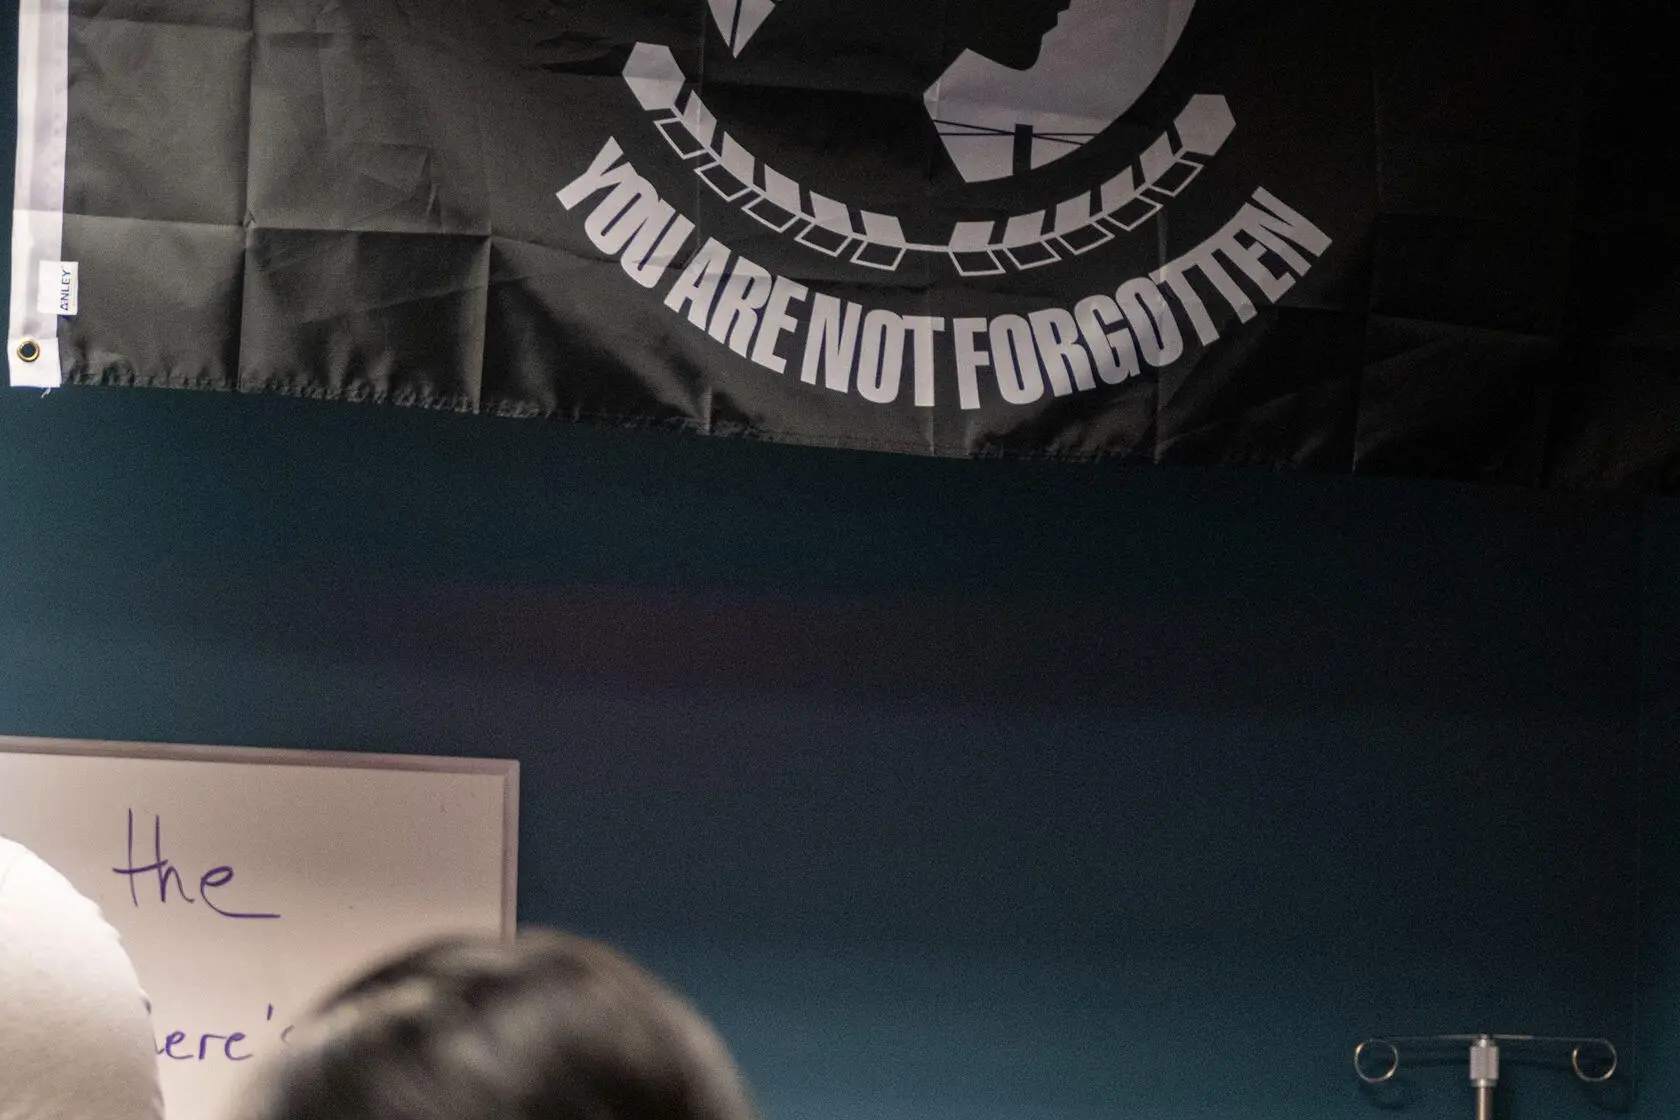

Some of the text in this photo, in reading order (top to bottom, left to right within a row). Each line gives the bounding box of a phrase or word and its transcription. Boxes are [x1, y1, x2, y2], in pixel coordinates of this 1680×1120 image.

[59, 268, 71, 311] ANLEY
[555, 136, 1333, 410] YOU ARE NOT FORGOTTEN
[113, 807, 281, 919] the
